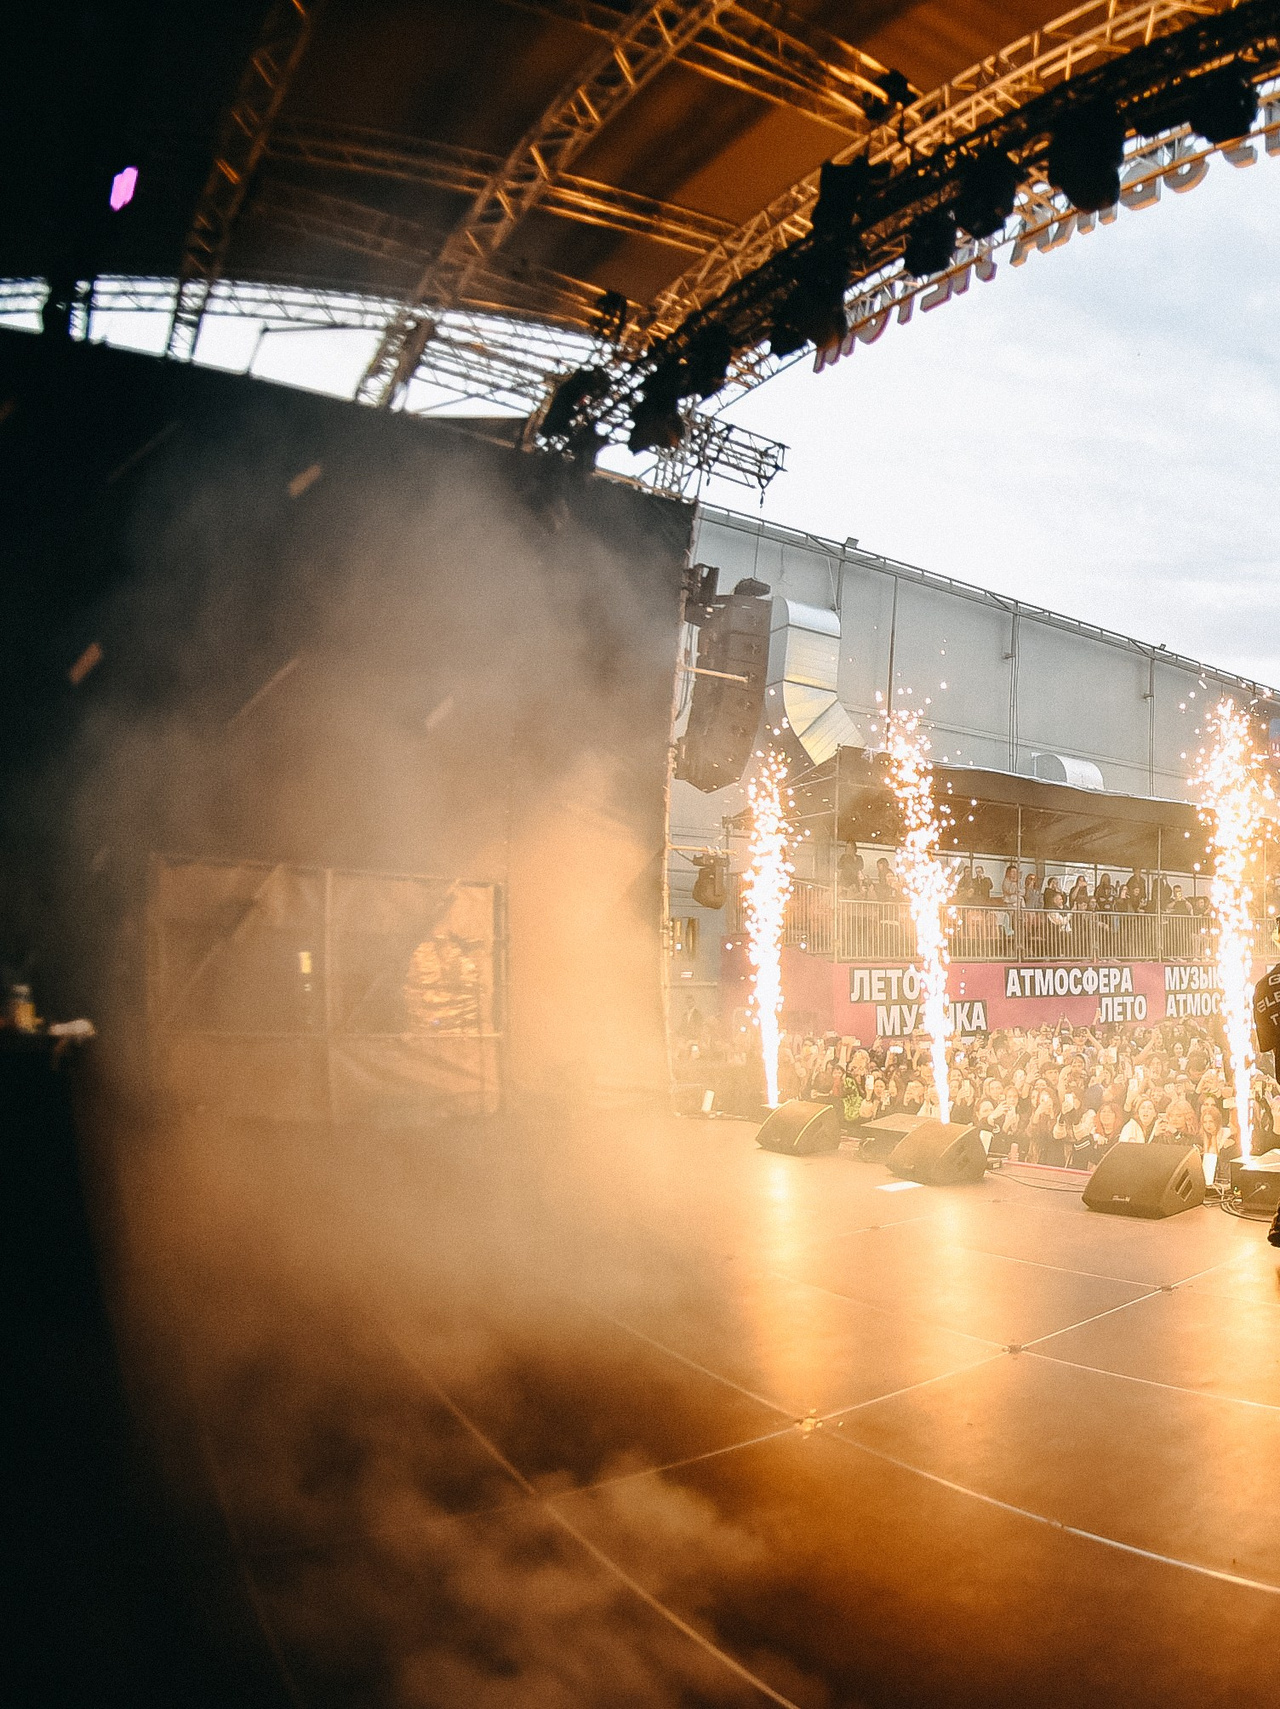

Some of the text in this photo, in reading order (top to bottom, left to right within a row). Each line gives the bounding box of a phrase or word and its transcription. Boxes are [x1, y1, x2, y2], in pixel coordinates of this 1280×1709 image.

[850, 969, 921, 1002] ЛЕТО
[1006, 967, 1133, 997] АТМОСФЕРА
[1164, 966, 1224, 991] МУЗЫК
[876, 1001, 987, 1037] МУКА
[1100, 995, 1148, 1023] ЛЕТО
[1166, 992, 1222, 1018] АТМОС
